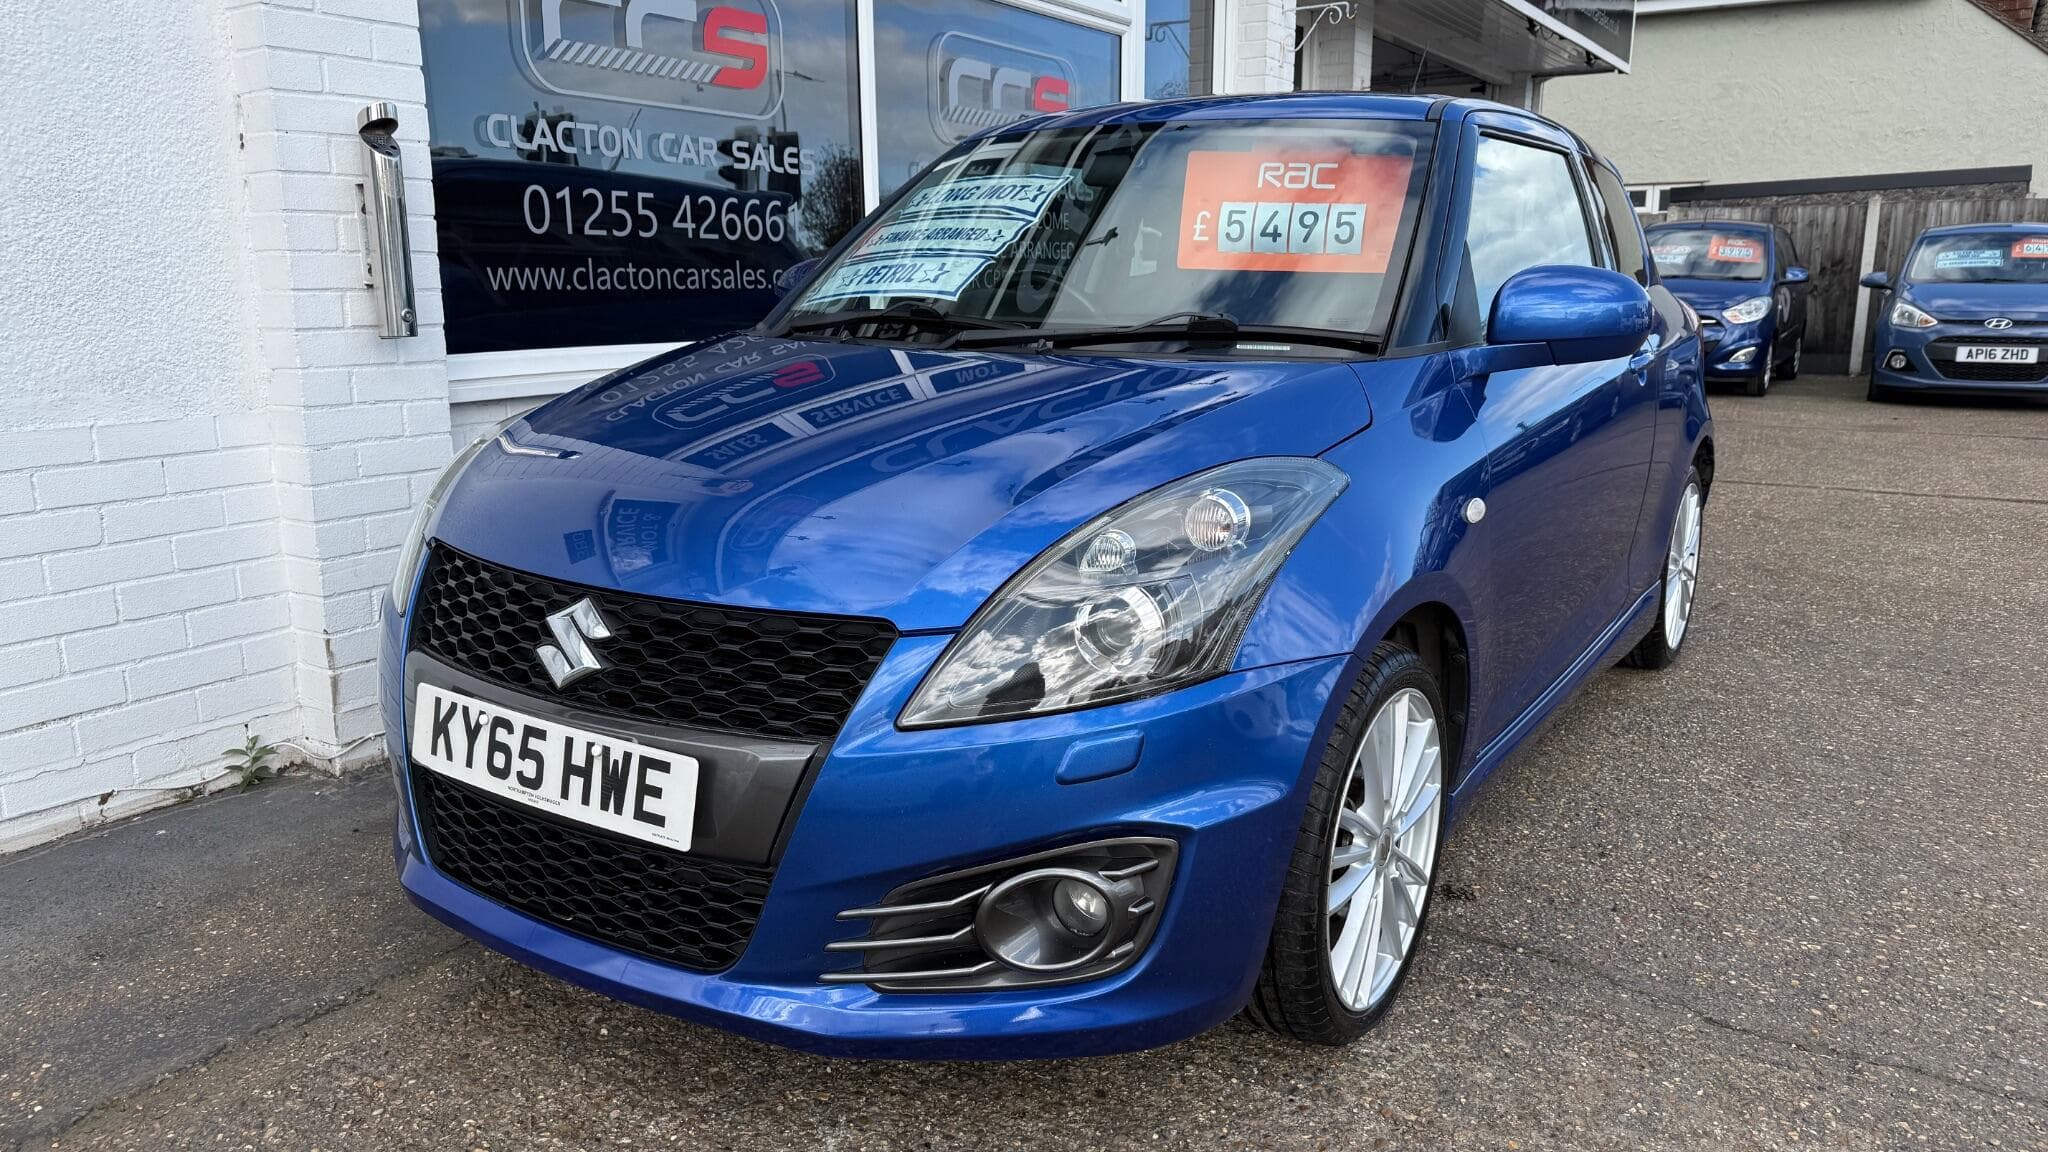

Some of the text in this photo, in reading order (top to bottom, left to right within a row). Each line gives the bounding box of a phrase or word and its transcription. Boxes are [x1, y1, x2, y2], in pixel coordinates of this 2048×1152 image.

[486, 113, 815, 175] CLACTON CAR SALES
[978, 184, 1032, 201] MOT
[523, 184, 802, 242] 01255 426661
[923, 227, 990, 241] ARRANGED
[1011, 242, 1076, 260] ARRANGED
[486, 258, 784, 291] www.clactoncarsales.c
[855, 263, 924, 286] PETROL
[1966, 348, 2029, 360] AP16 ZHD
[430, 696, 672, 828] KY65 HWE
